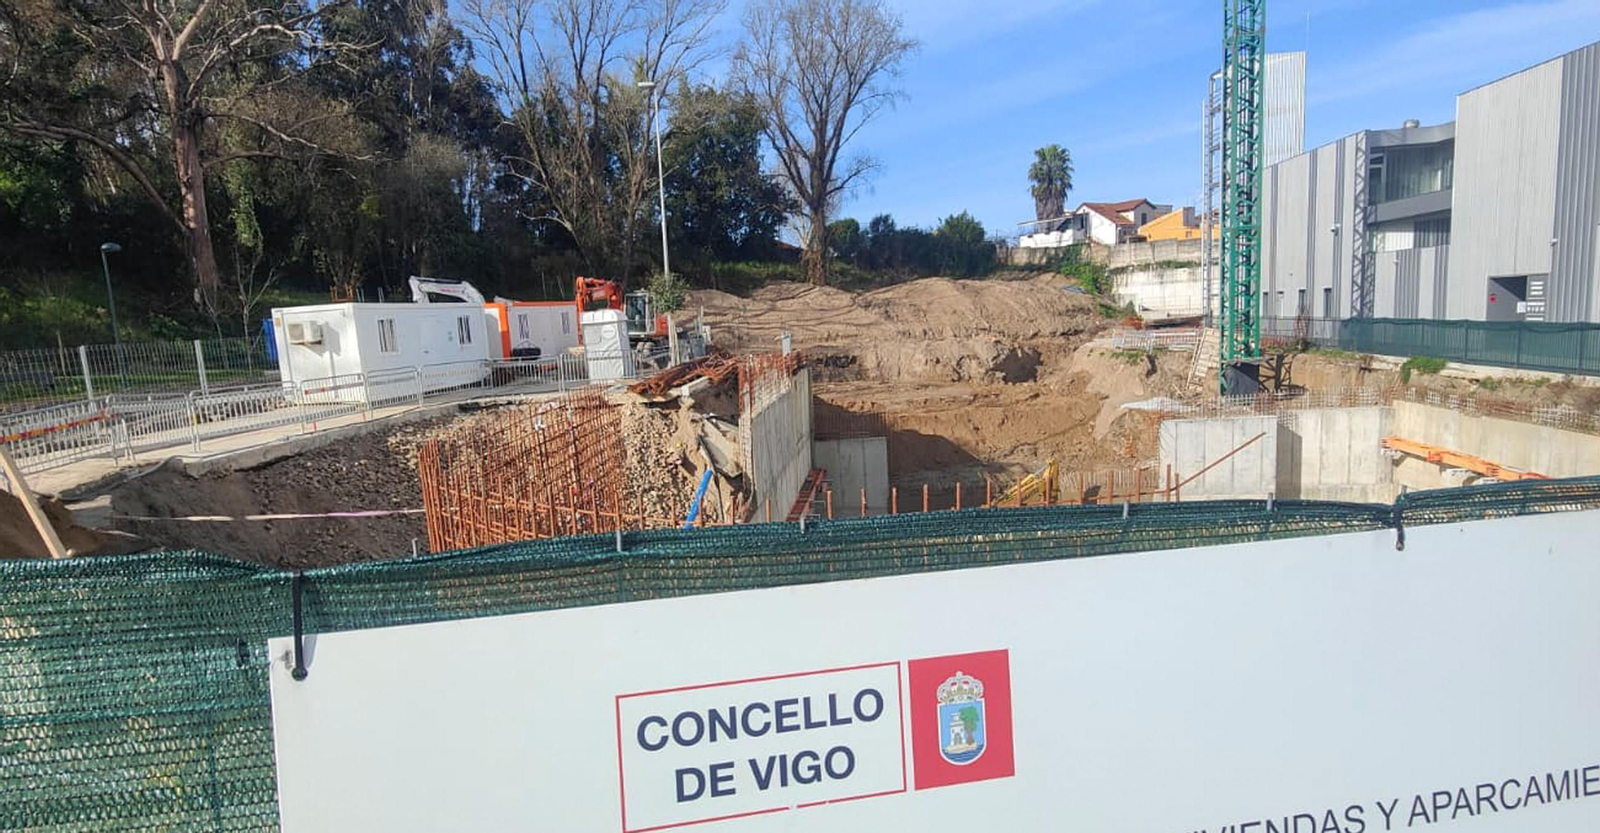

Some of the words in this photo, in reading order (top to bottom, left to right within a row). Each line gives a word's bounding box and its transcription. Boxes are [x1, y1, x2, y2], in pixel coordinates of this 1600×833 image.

[636, 688, 885, 752] CONCELLO
[675, 761, 737, 803] DE
[748, 745, 856, 791] VIGO
[1375, 798, 1399, 831] Y
[1407, 764, 1600, 828] APARCAMIE
